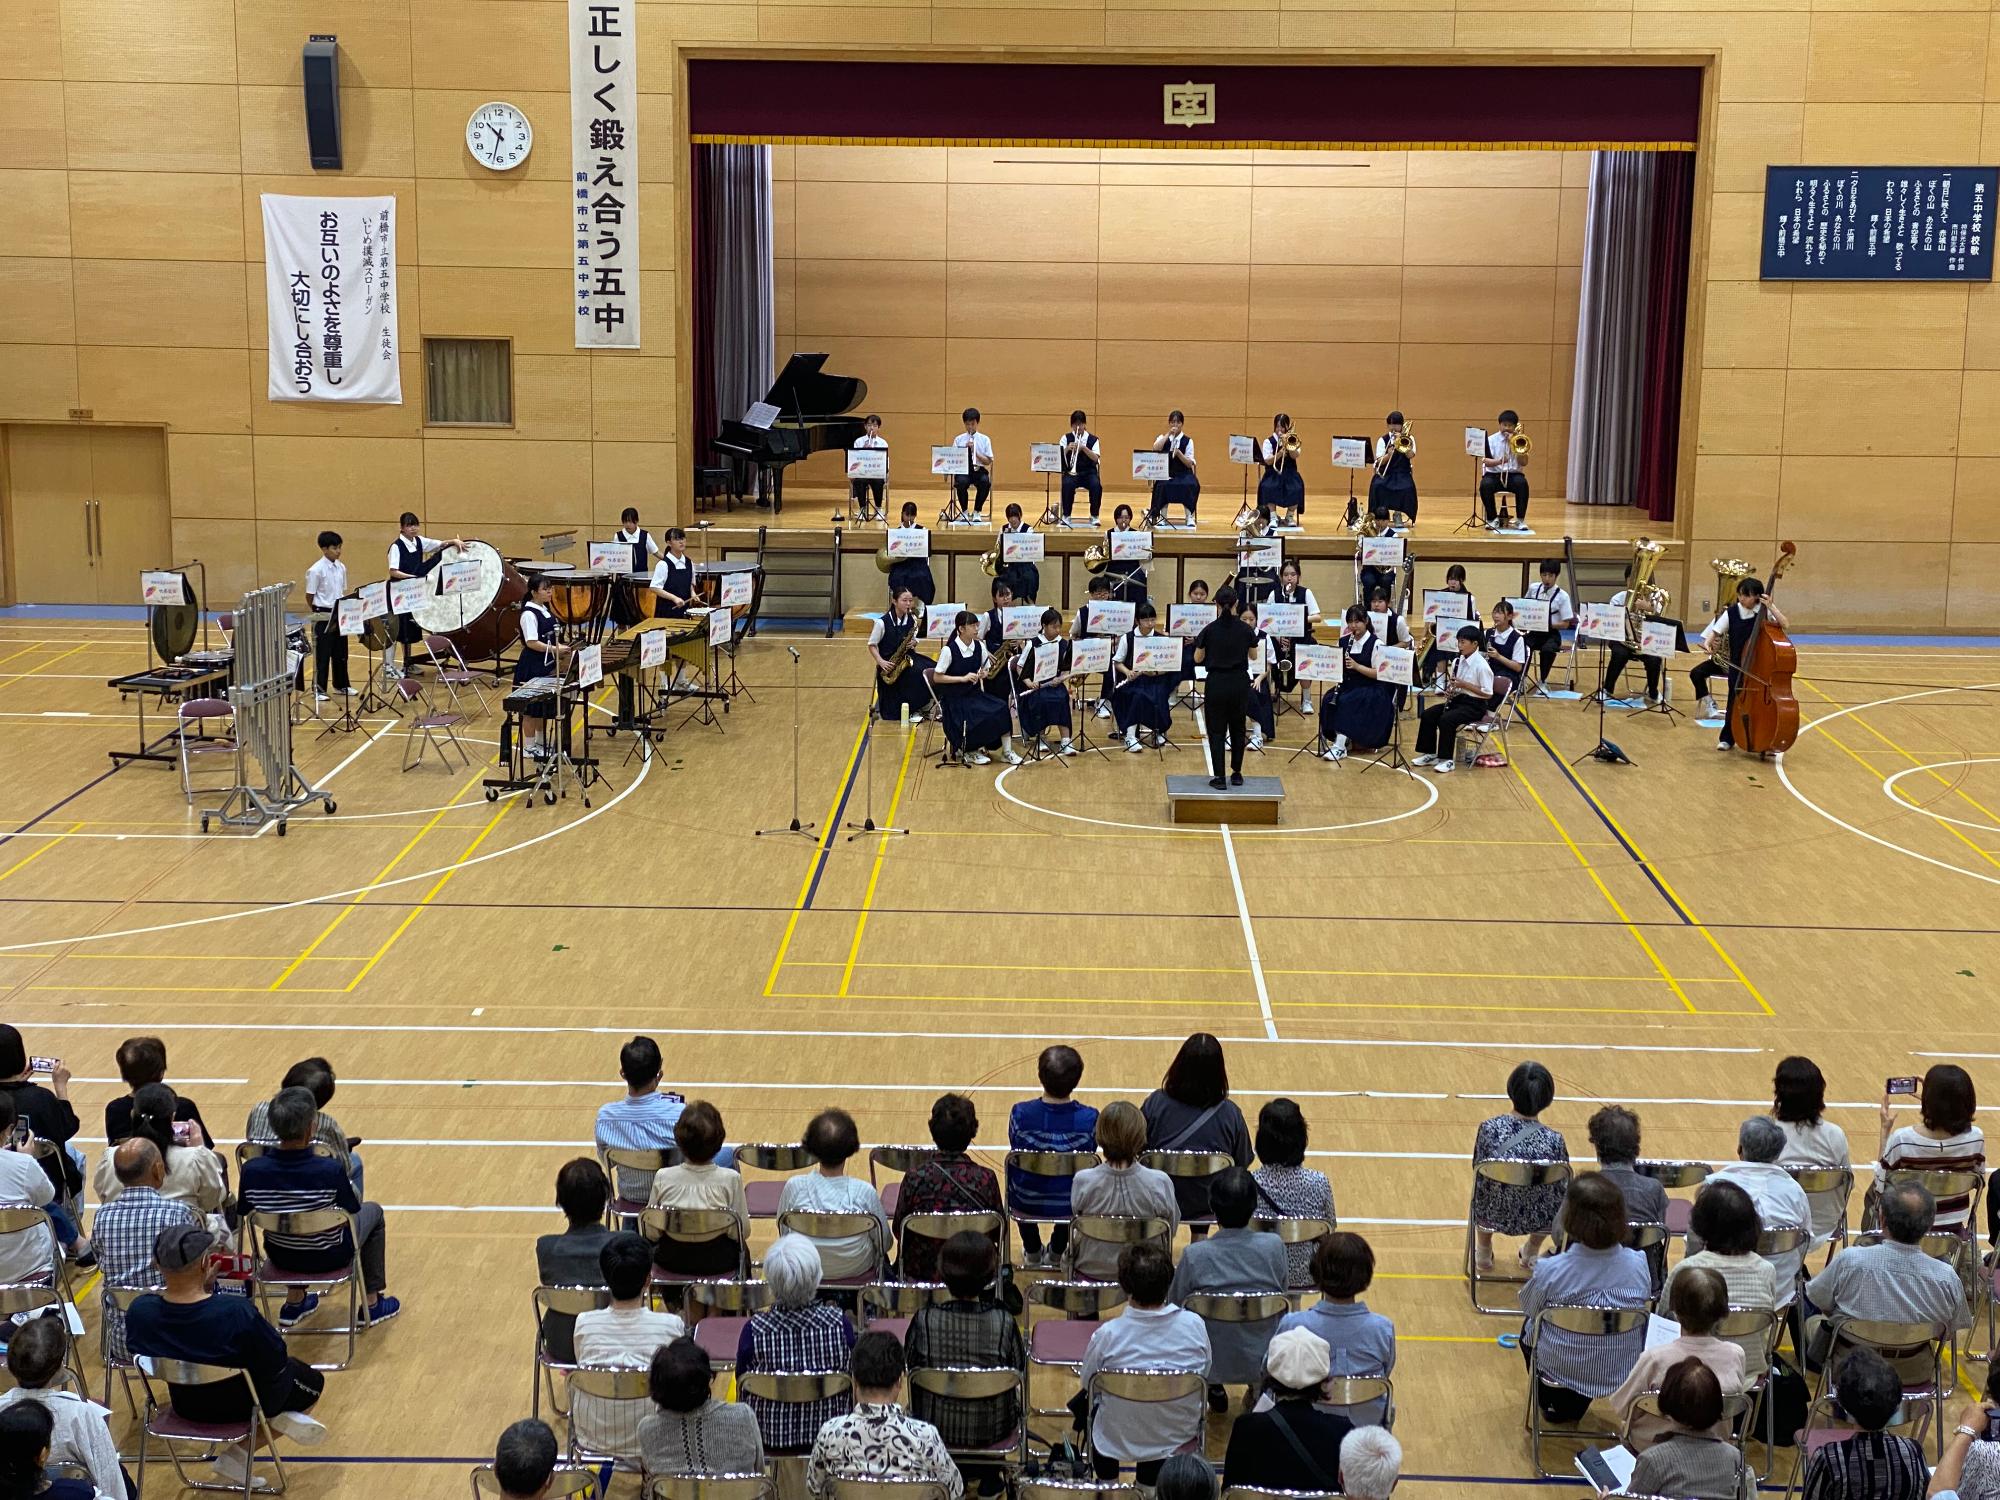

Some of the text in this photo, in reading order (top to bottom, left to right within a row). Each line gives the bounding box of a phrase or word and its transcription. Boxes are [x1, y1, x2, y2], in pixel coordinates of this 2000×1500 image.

[588, 5, 625, 333] 正しく鍛え合う五中
[1795, 179, 1804, 202] われら
[1821, 179, 1831, 216] ふるさとの
[1886, 180, 1895, 202] われら
[1912, 180, 1923, 216] ふるさとの
[575, 171, 590, 317] 前橋市立第五中学校
[1832, 179, 1846, 250] ぼくの川 あなたの川
[1924, 180, 1938, 251] ぼくの山 あなたの山
[1970, 183, 1985, 256] 第五中学校 校歌
[319, 211, 343, 385] お互いのよさを尊重し
[362, 217, 374, 316] いじめ撲滅スローガン
[378, 209, 392, 361] 前橋市立第五中学校 生徒会
[290, 270, 313, 394] 大切にし合おう
